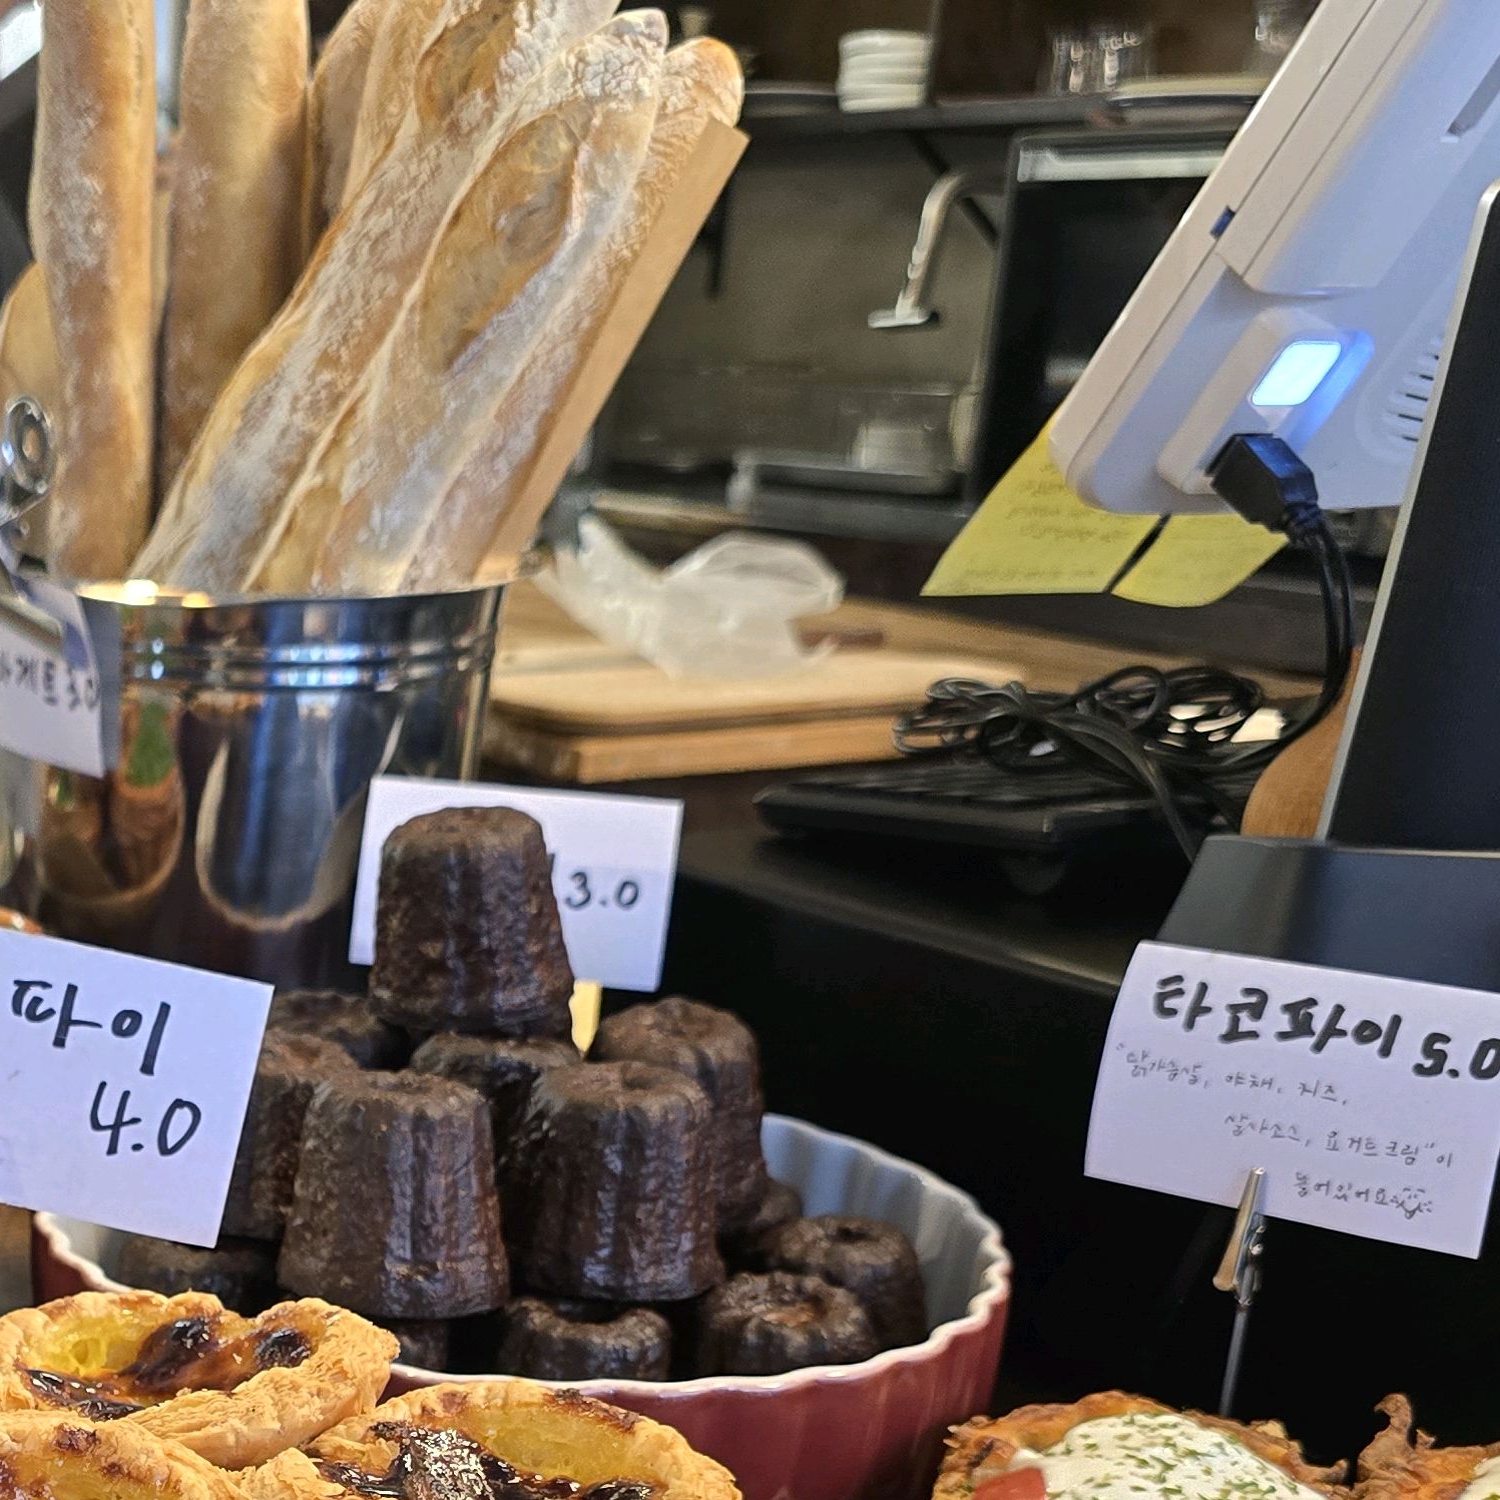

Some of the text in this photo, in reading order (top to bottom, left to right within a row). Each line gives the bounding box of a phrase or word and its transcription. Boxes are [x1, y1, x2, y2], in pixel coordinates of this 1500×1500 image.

[564, 870, 640, 909] 3.0
[1152, 974, 1500, 1082] 타코파이 5.0
[89, 1080, 202, 1158] 4.0
